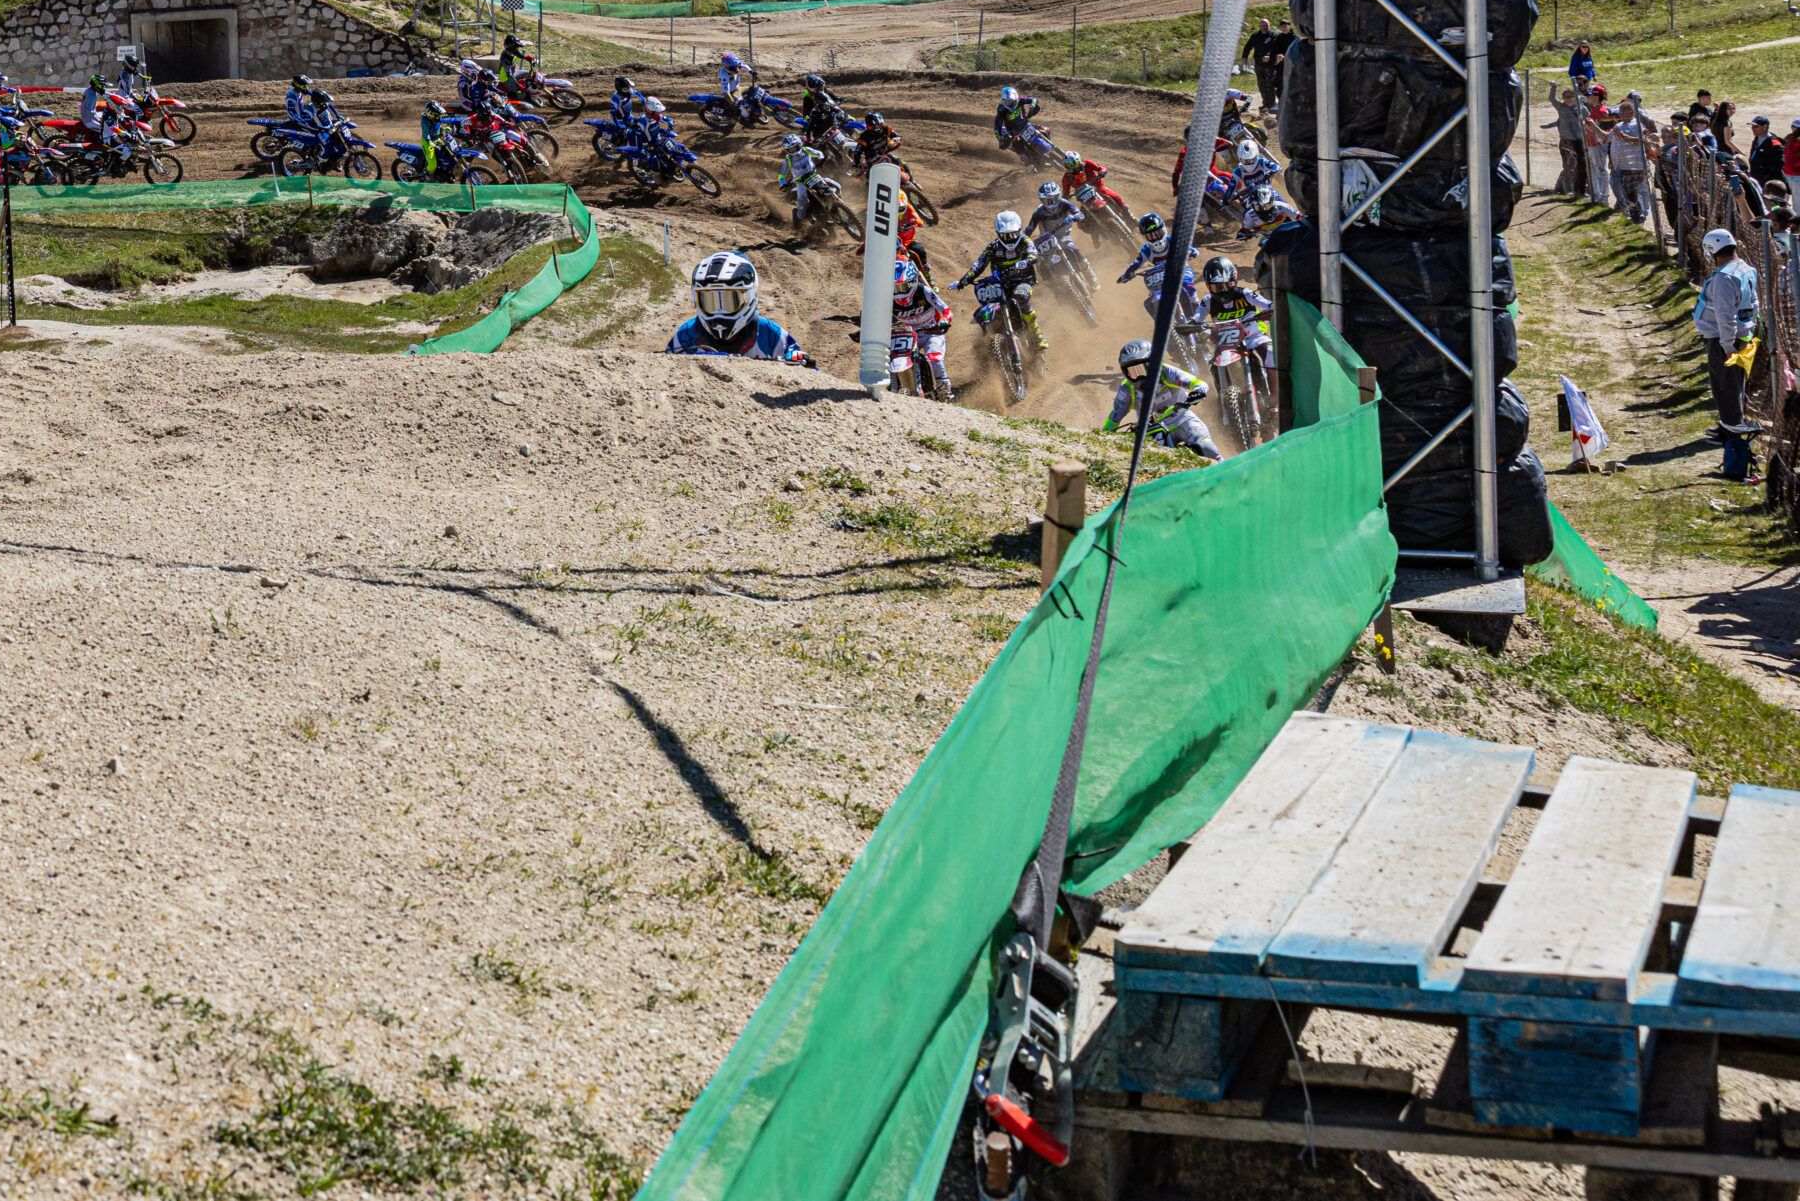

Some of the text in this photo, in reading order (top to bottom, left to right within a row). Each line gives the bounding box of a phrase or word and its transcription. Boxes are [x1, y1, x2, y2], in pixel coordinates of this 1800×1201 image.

[874, 183, 892, 237] UFO
[898, 305, 924, 318] UFO
[1216, 308, 1246, 320] UFO
[1217, 329, 1241, 345] 72
